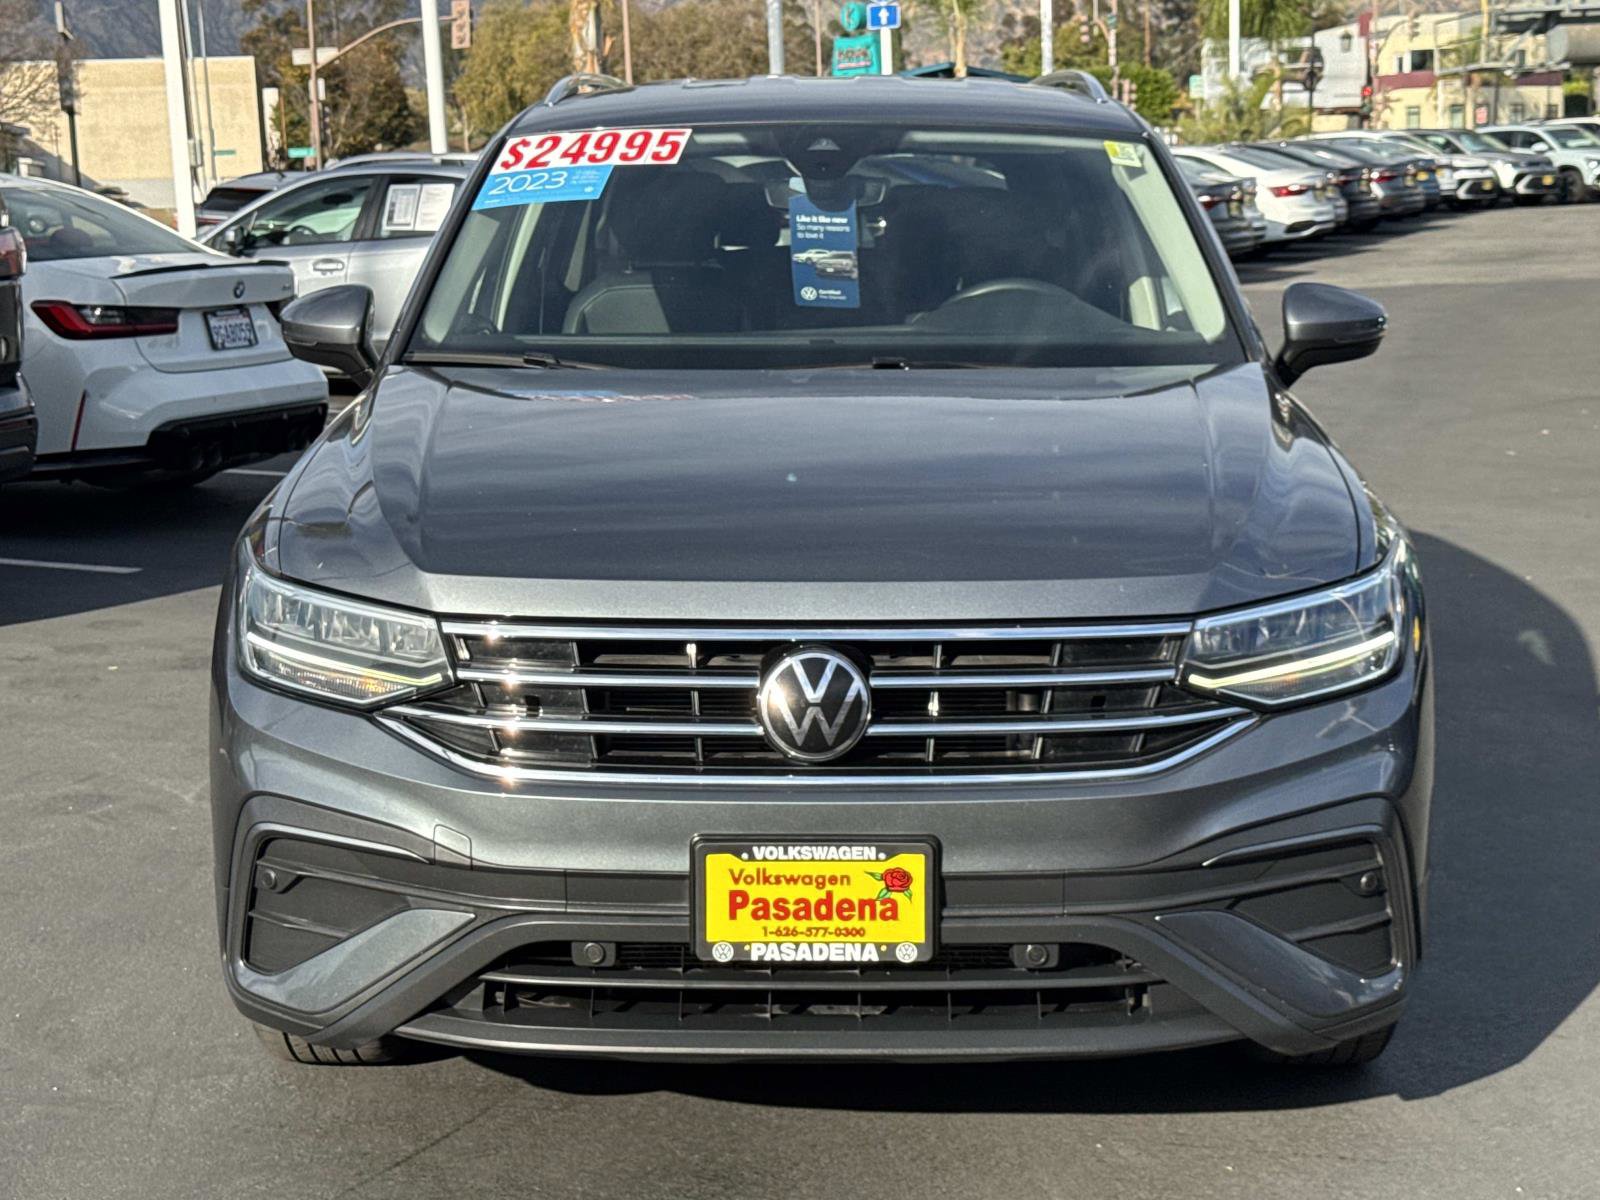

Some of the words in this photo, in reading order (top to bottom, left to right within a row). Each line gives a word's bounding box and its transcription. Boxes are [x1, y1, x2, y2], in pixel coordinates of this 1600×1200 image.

[501, 131, 686, 170] $24995
[488, 171, 568, 196] 2023
[752, 846, 877, 860] VOLKSWAGEN
[729, 868, 851, 887] Volkswagen
[729, 890, 899, 921] Pasadena
[763, 926, 865, 938] 1-626-577-0300
[751, 943, 879, 961] PASADENA
